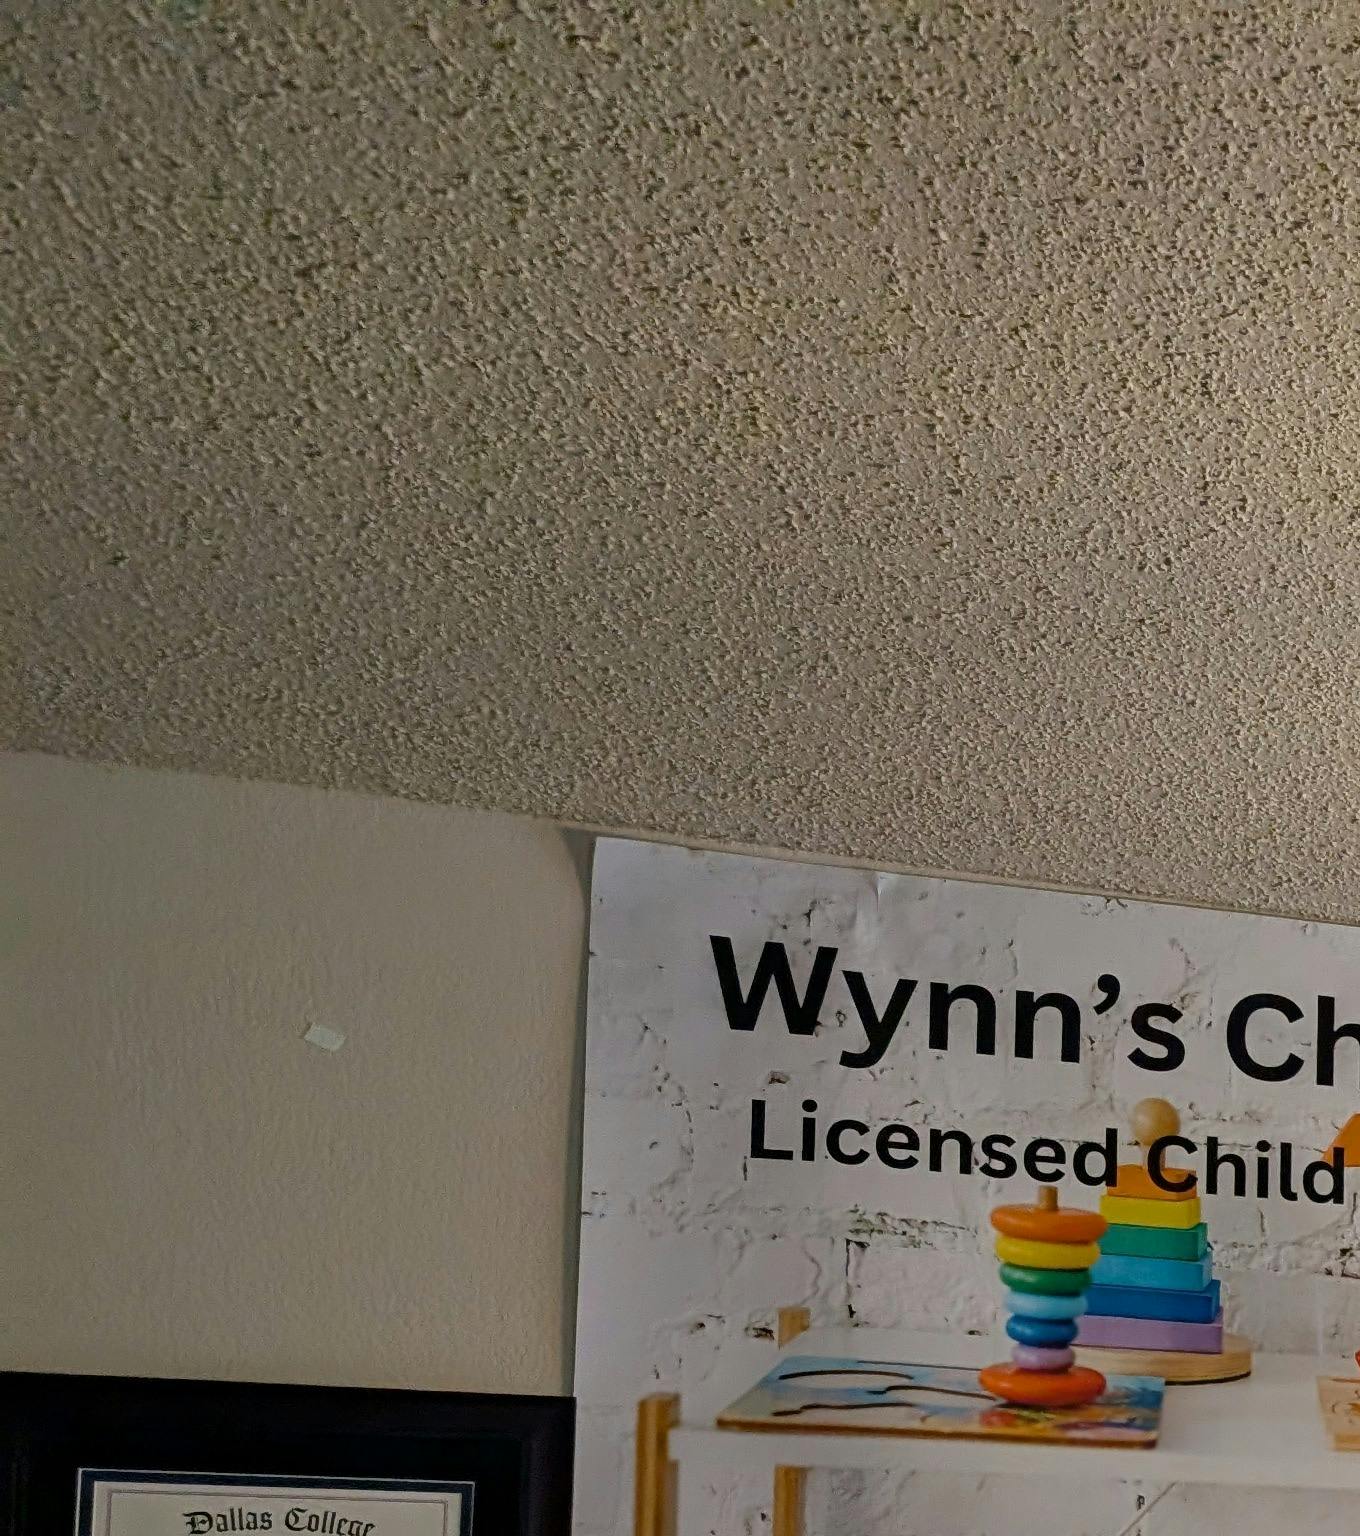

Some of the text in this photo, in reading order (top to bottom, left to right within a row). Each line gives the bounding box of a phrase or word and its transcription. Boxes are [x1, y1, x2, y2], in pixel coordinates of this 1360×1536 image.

[748, 1097, 1120, 1187] Licensed
[1146, 1127, 1346, 1208] Child
[182, 1507, 273, 1535] Dallas
